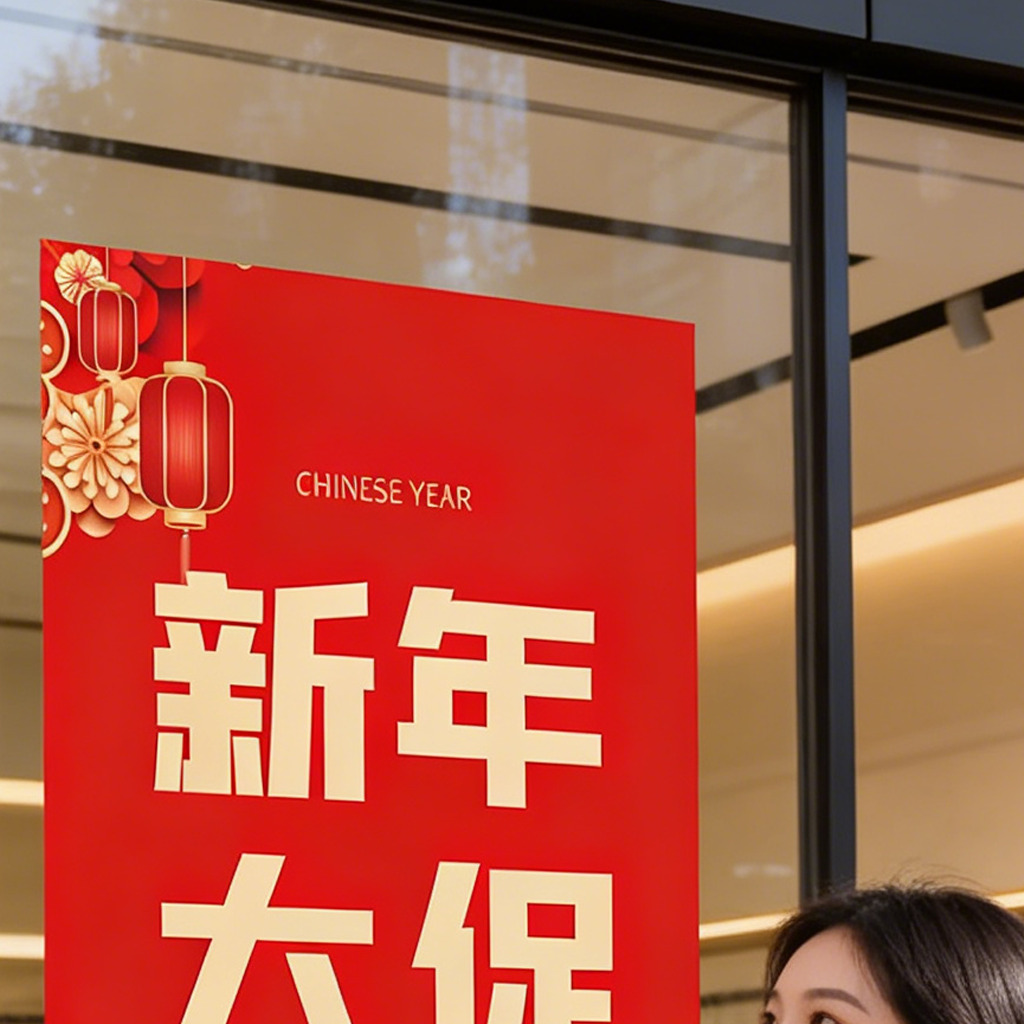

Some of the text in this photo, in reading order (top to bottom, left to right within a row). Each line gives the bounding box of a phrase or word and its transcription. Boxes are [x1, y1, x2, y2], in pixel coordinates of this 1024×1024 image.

[296, 471, 472, 512] CHINESE YEAR
[153, 570, 603, 810] 新年
